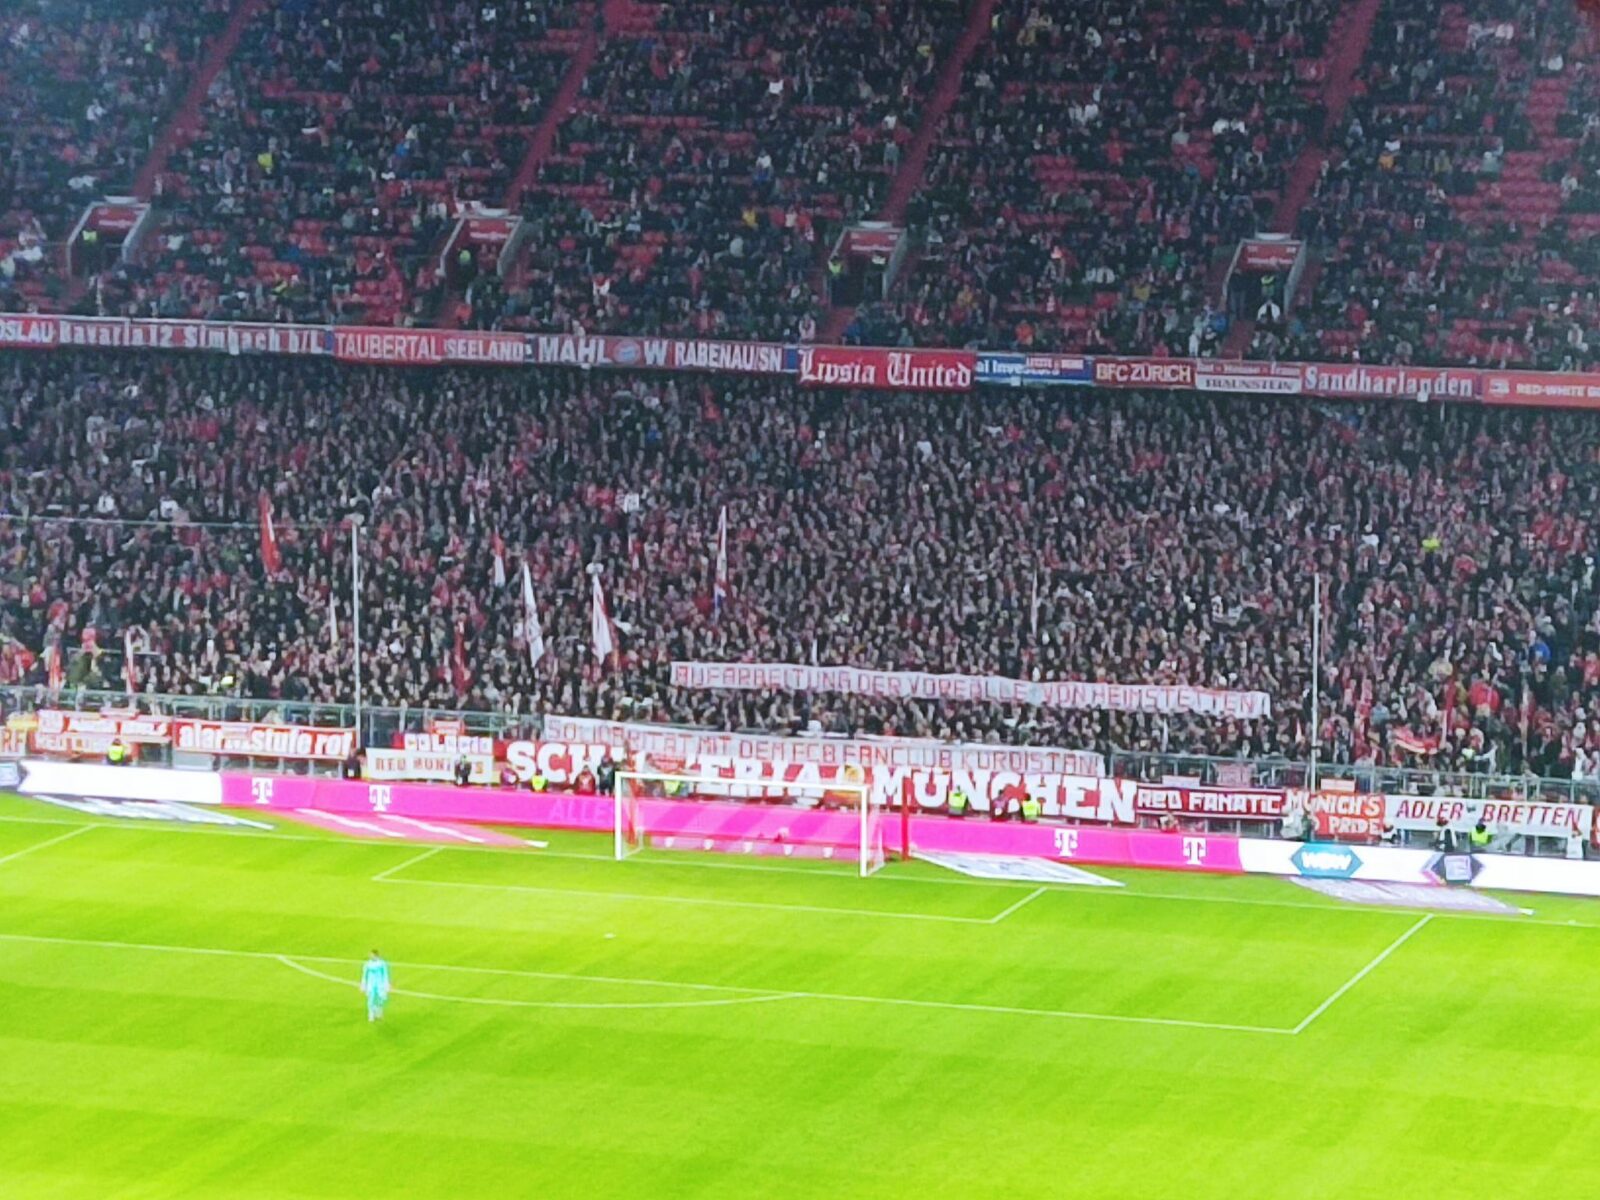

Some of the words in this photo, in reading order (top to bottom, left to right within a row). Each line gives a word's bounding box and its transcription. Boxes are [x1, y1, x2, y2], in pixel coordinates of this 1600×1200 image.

[335, 332, 442, 361] TAUBERTAL
[538, 336, 613, 363] MAHL
[798, 349, 876, 385] Lipsia
[886, 352, 971, 388] United
[675, 664, 851, 692] AUFARBEITUNG
[858, 674, 902, 696] DER
[1043, 684, 1087, 706] VON
[698, 734, 733, 756] MIT
[739, 738, 785, 761] DEM
[792, 742, 837, 765] FCB
[843, 743, 952, 769] FANCLUB
[507, 741, 831, 797] SCHERIA
[871, 764, 1137, 824] MÜNCHEN
[1189, 792, 1282, 815] FANATIC
[1396, 800, 1465, 821] ADLER
[1482, 803, 1583, 828] BRETTEN
[1328, 816, 1382, 835] PRIDE
